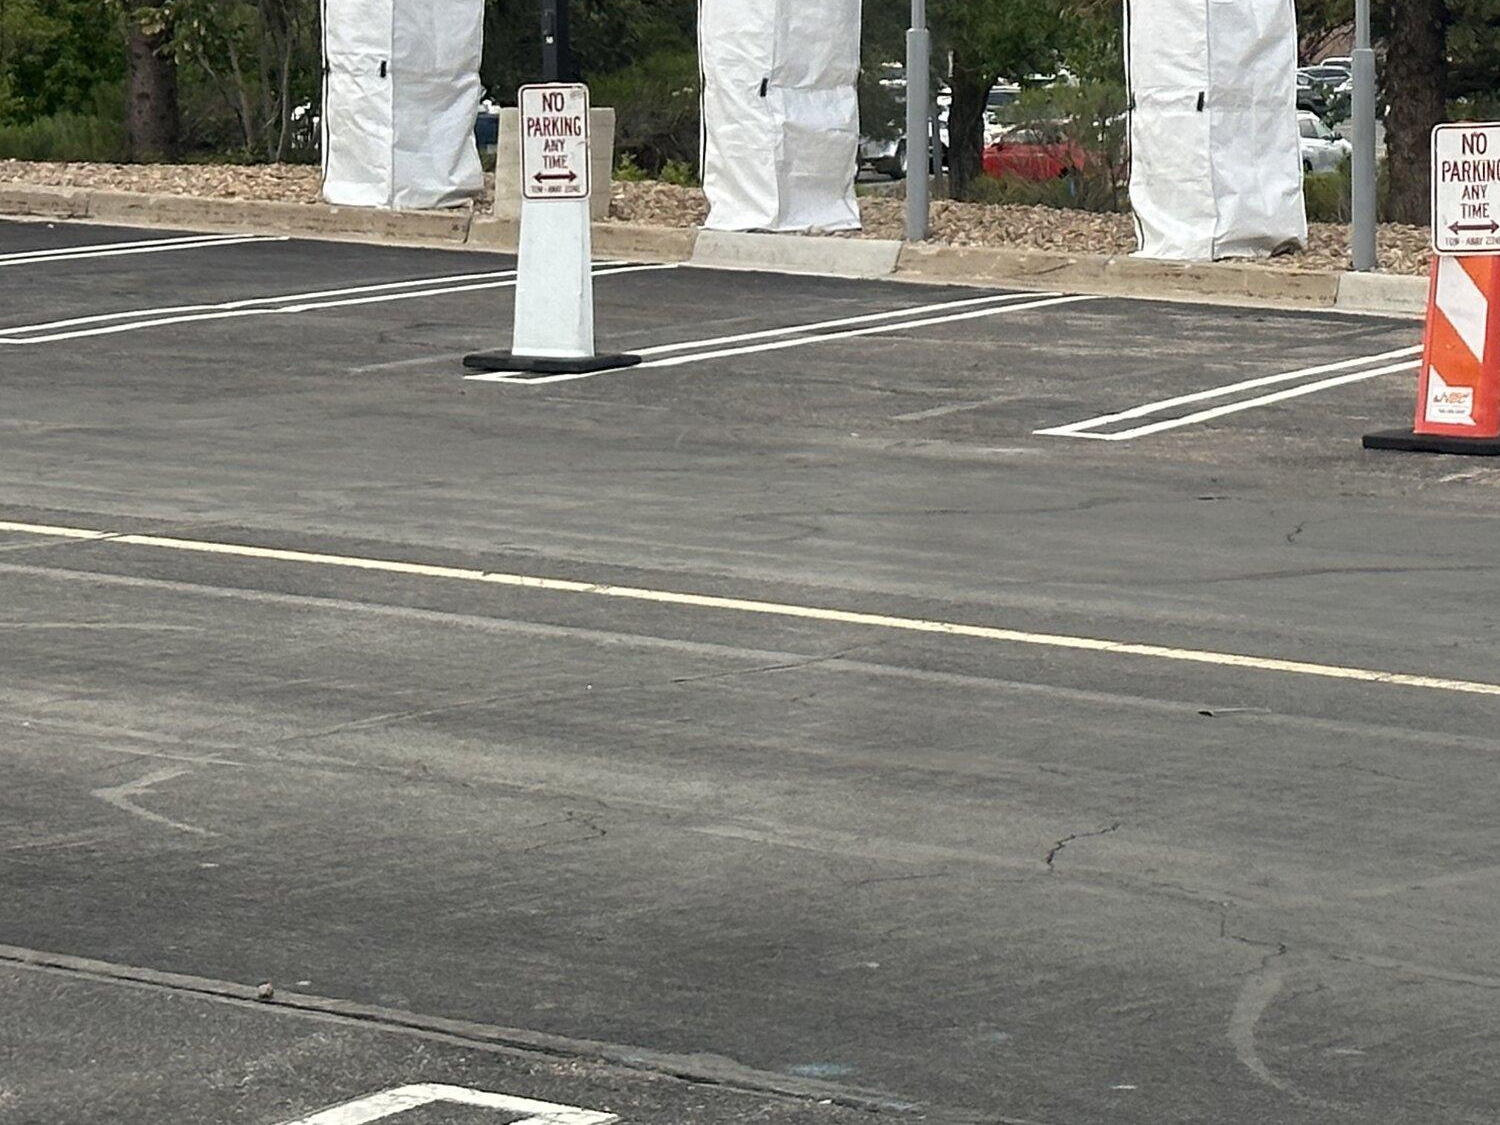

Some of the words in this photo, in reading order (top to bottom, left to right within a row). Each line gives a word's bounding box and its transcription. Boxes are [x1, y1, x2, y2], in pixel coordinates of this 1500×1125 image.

[542, 91, 565, 112] NO
[526, 115, 582, 137] PARKING
[543, 139, 566, 153] ANY
[1462, 132, 1487, 155] NO
[542, 155, 568, 169] TIME
[1461, 184, 1488, 200] ANY
[1460, 202, 1490, 219] TIME
